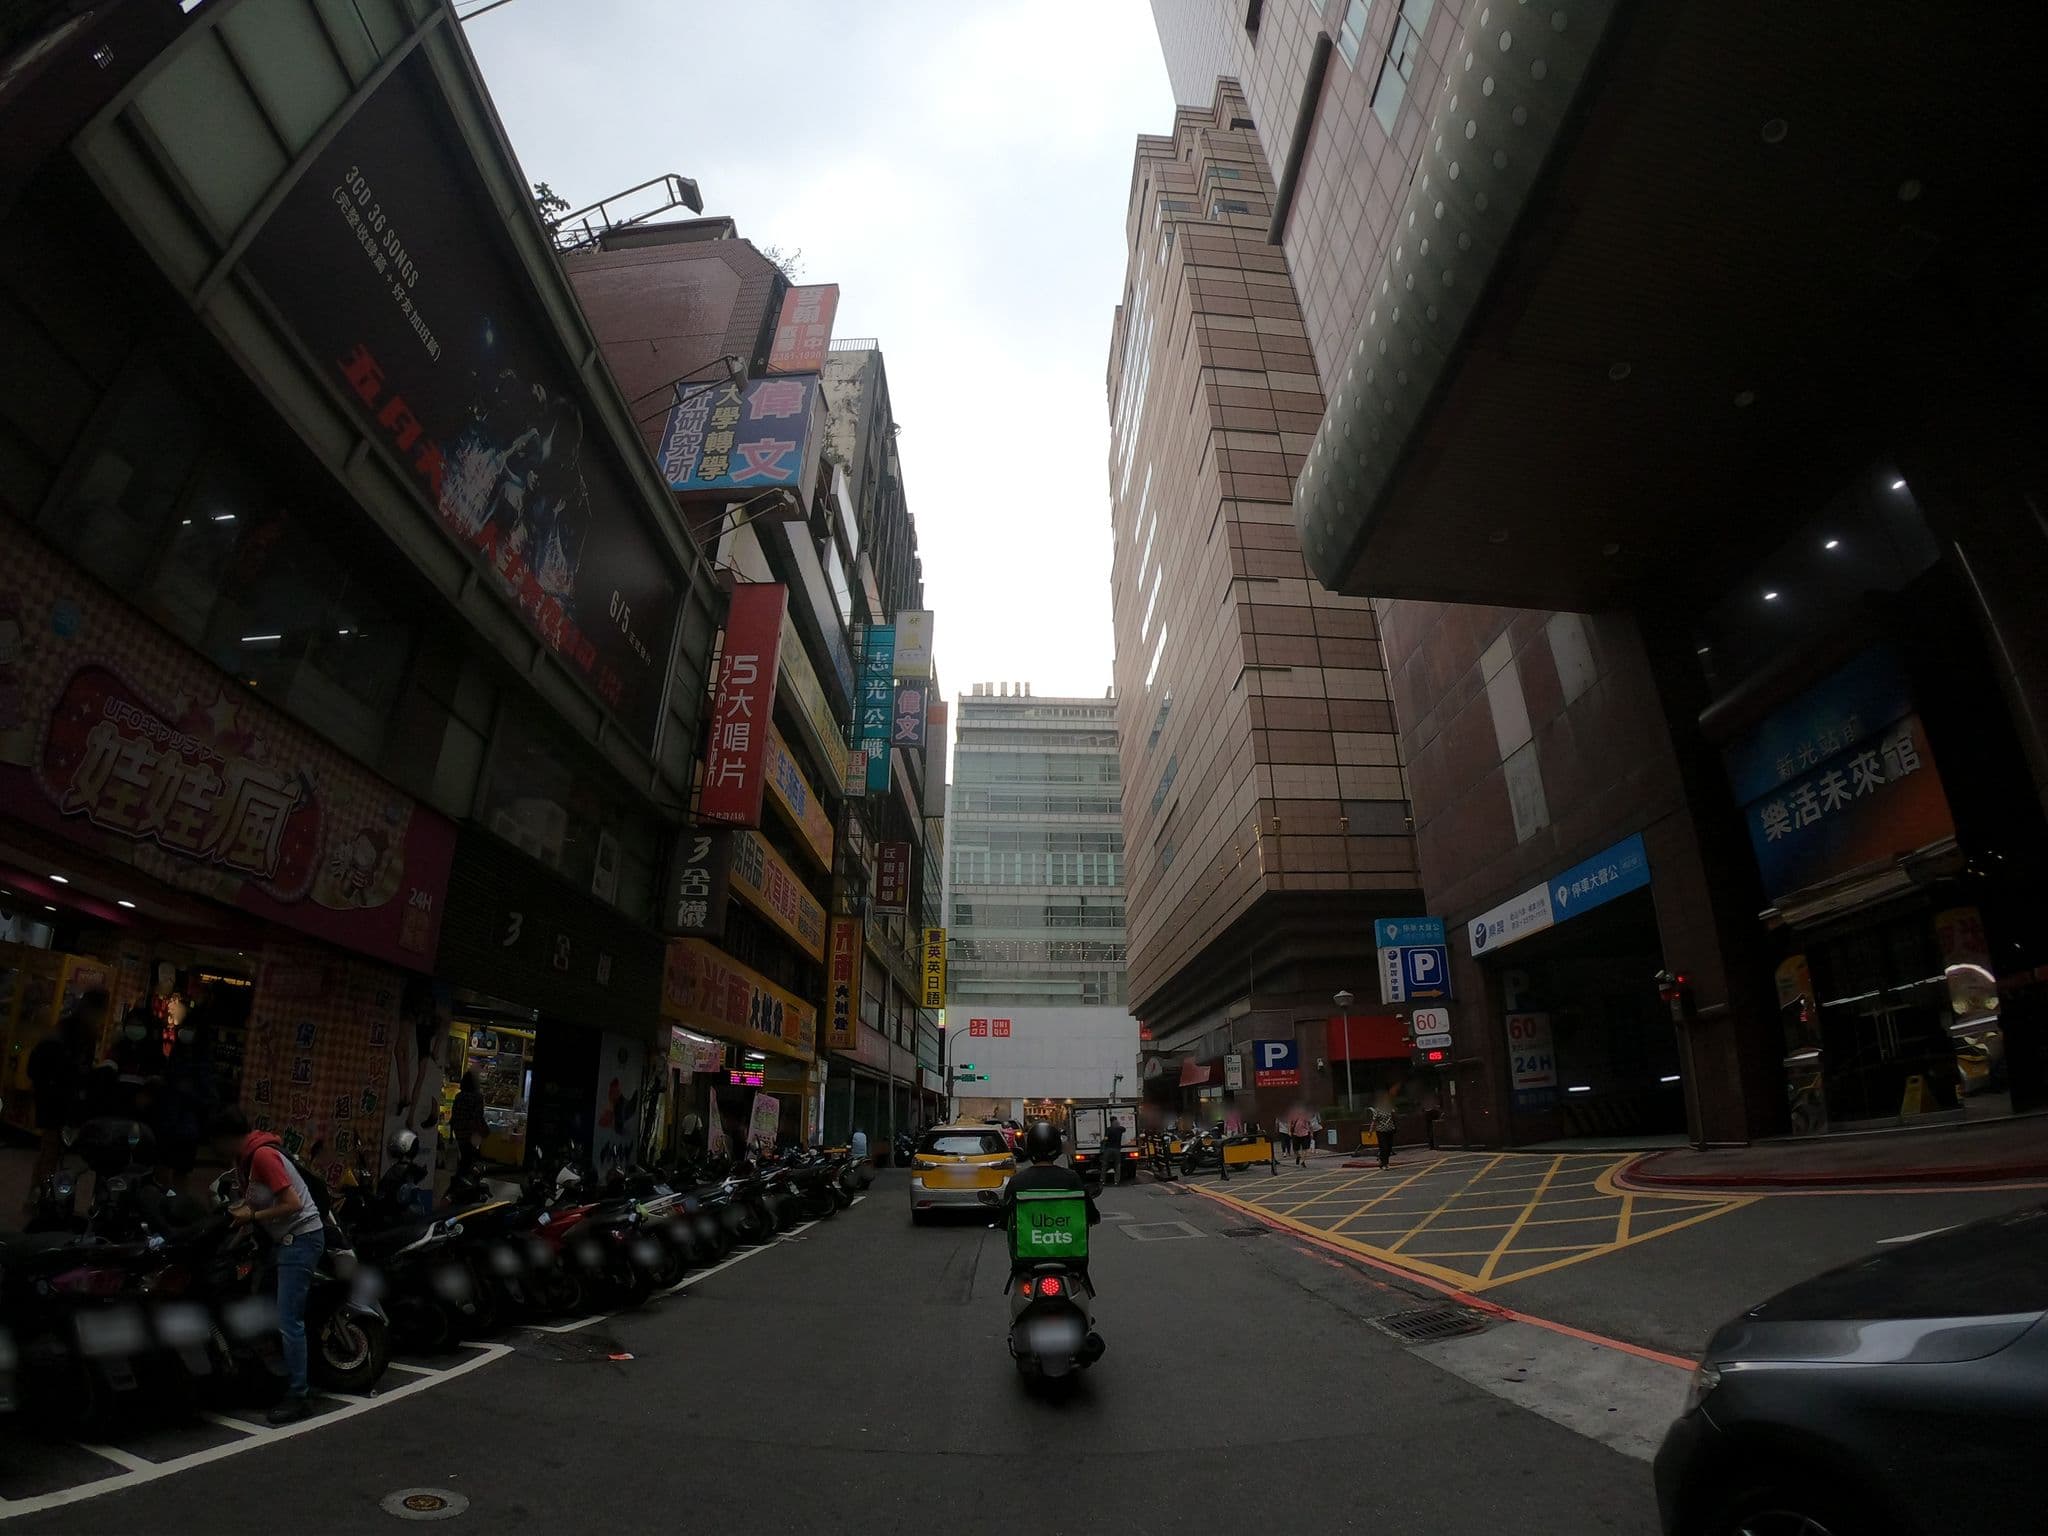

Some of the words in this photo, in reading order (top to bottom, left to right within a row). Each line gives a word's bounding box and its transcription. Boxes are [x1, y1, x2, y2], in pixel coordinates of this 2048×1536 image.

[346, 166, 372, 206] 3CD
[368, 203, 386, 233] 36
[383, 229, 419, 288] SONGS
[697, 384, 743, 481] 大學轉學
[729, 380, 806, 482] 偉文
[609, 590, 631, 633] 6/5
[717, 655, 759, 789] 5大唱片
[1760, 733, 1921, 843] 樂活未來館
[408, 888, 433, 911] 24H
[1414, 953, 1435, 981] P
[1416, 1013, 1437, 1031] 60
[1509, 1018, 1537, 1040] 60
[1264, 1042, 1289, 1069] P
[1514, 1055, 1552, 1074] 24H
[1031, 1213, 1071, 1228] Uber
[1031, 1229, 1073, 1245] Eats
